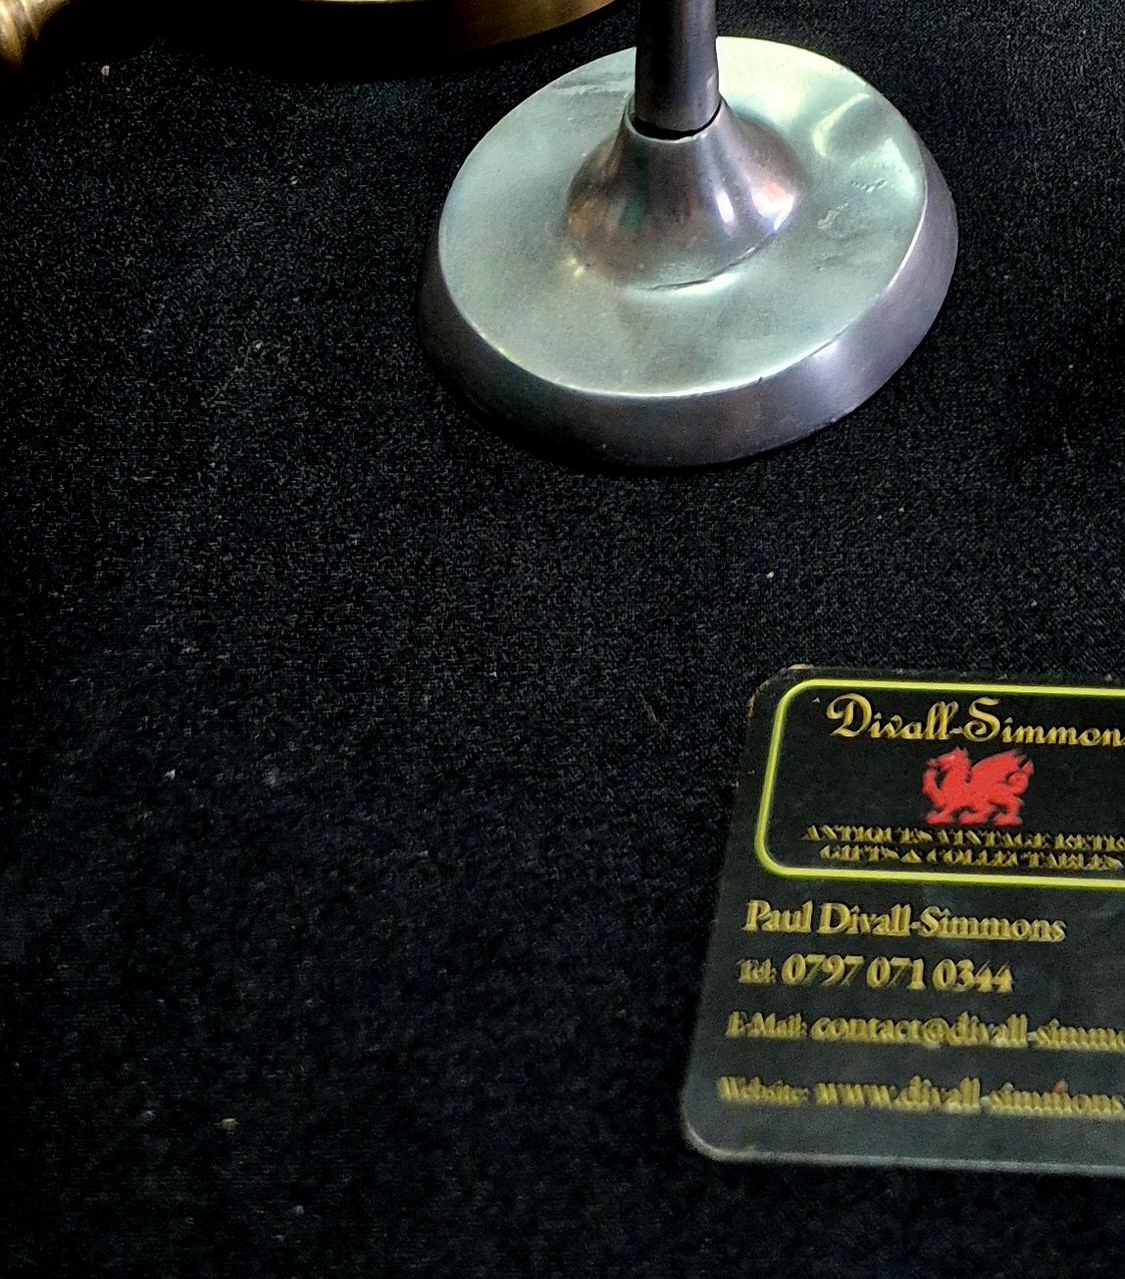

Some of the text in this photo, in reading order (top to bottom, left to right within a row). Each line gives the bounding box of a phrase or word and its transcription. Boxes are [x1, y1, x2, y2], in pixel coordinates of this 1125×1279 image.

[743, 898, 1068, 943] Paul Divall-Simmons
[781, 952, 865, 987] 0797
[866, 955, 927, 991] 071
[932, 957, 1014, 993] 0344
